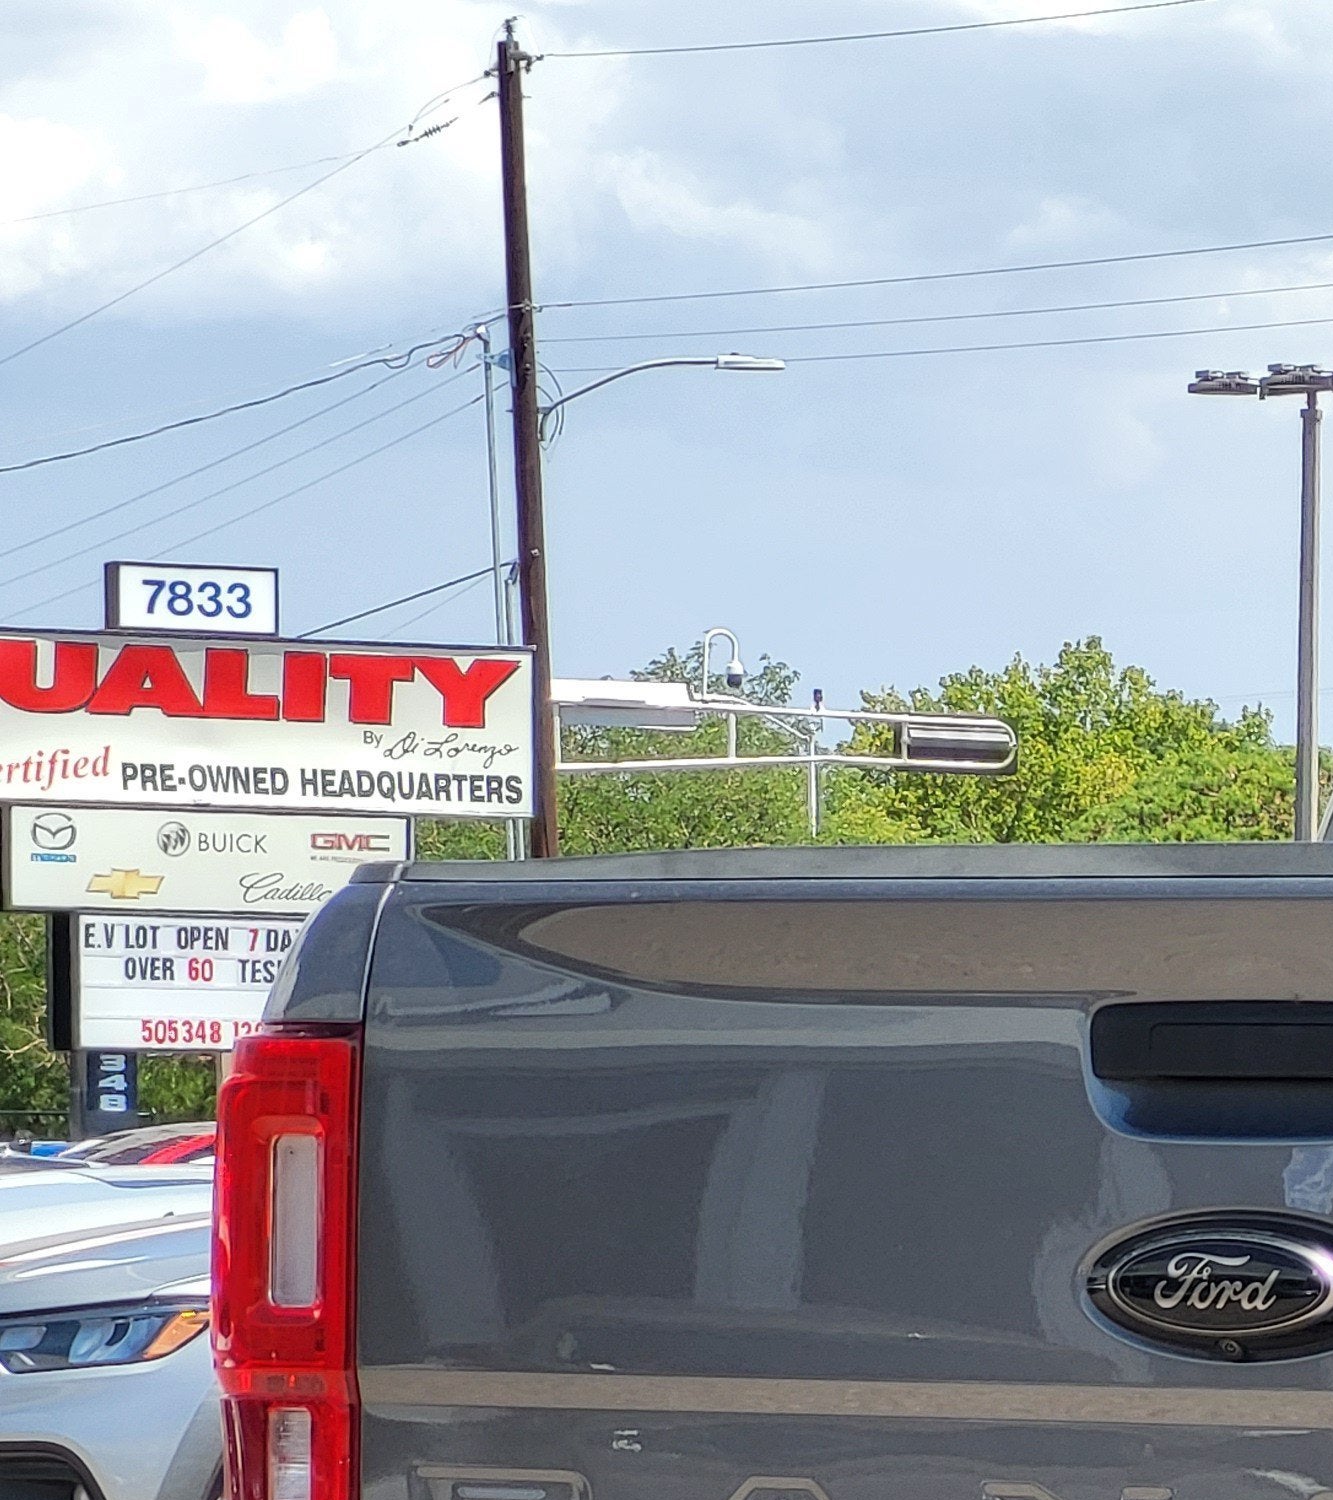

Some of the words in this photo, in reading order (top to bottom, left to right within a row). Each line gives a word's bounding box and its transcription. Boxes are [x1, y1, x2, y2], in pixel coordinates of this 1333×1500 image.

[142, 579, 252, 619] 7833
[363, 730, 384, 748] By
[0, 745, 111, 791] rtified
[121, 762, 289, 795] PRE-OWNED
[300, 768, 523, 804] HEADQUARTERS
[198, 832, 267, 854] BUICK
[310, 833, 390, 852] GMC
[124, 924, 161, 949] LOT
[176, 927, 229, 951] OPEN
[249, 928, 259, 952] 7
[266, 929, 300, 952] DA
[124, 957, 175, 981] OVER
[188, 957, 214, 982] 60
[141, 1019, 222, 1044] 505348
[1153, 1251, 1281, 1311] Ford
